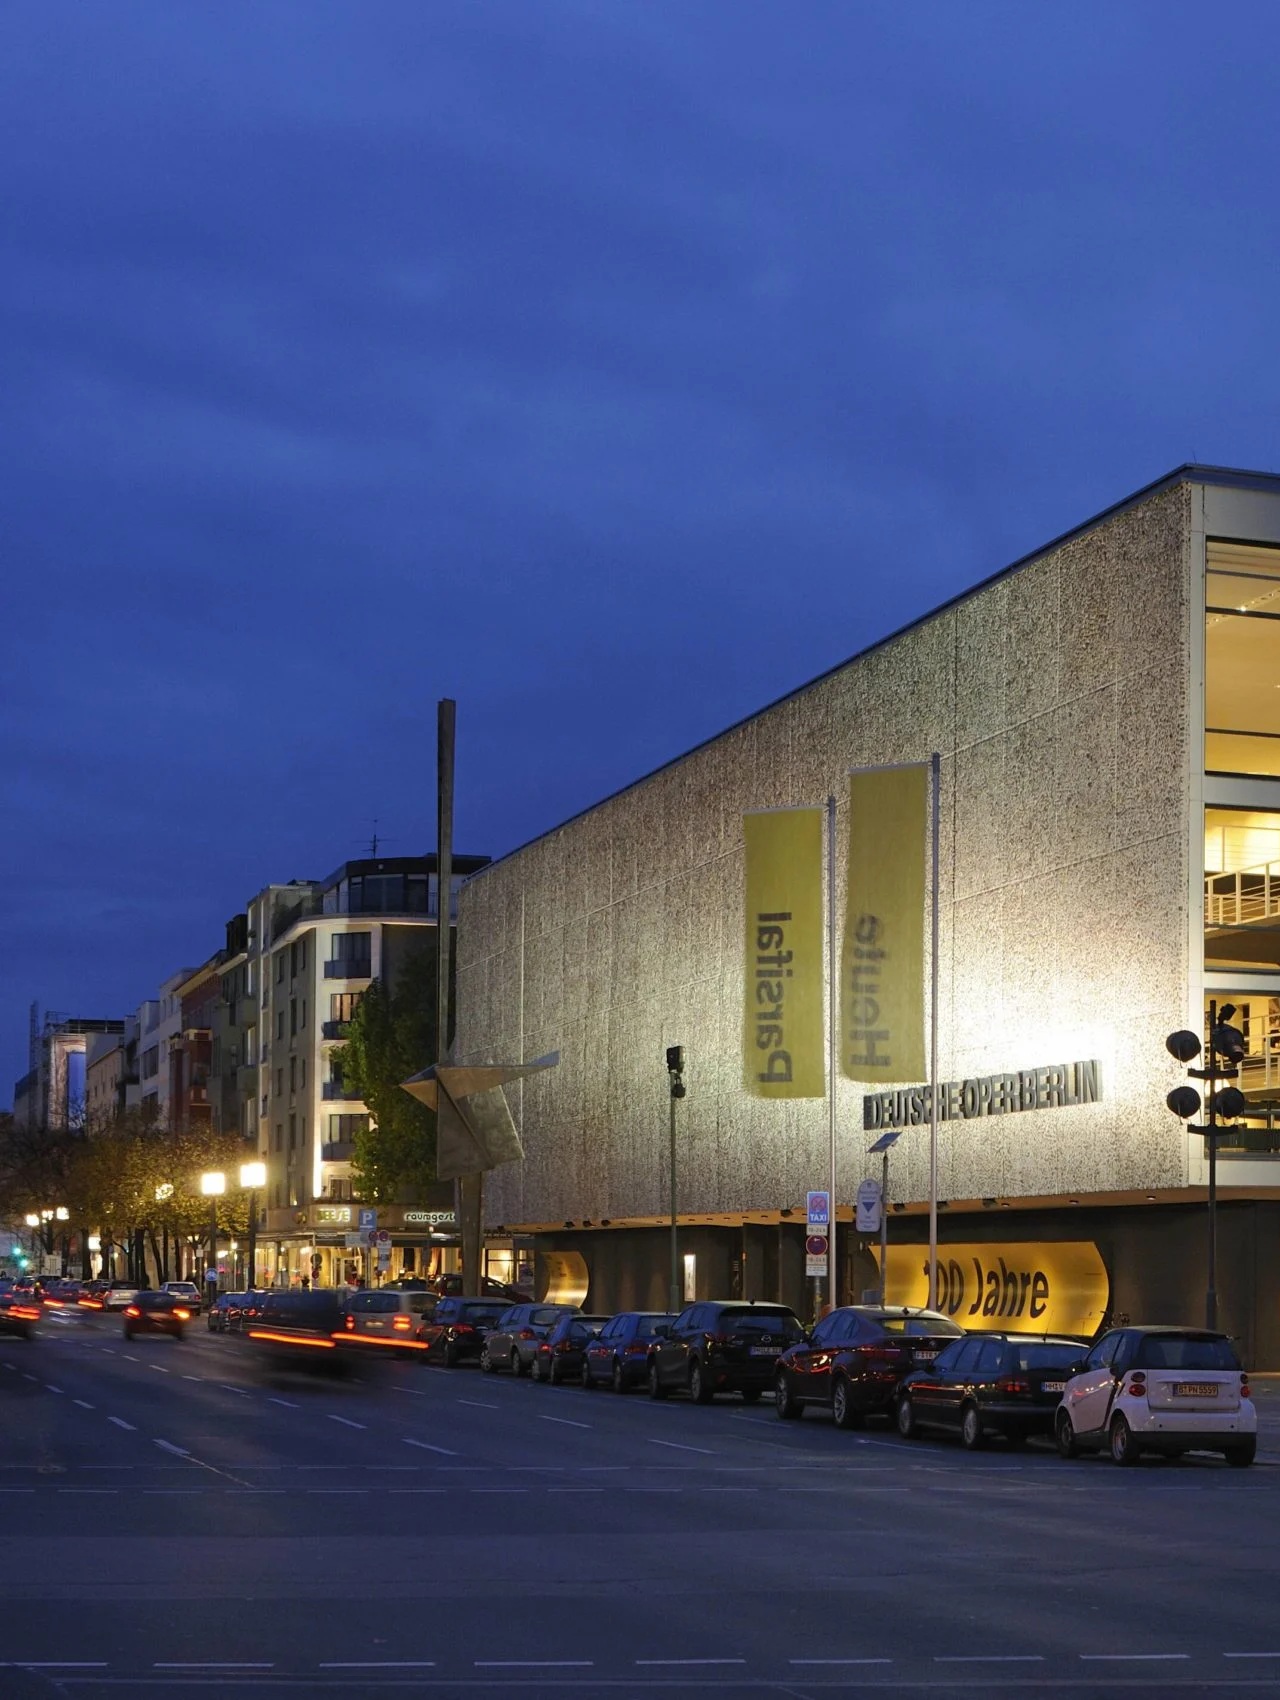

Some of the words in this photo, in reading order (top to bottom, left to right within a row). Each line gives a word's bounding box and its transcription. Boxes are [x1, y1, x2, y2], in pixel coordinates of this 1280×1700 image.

[863, 1081, 964, 1130] DEUTSCHE
[963, 1072, 1020, 1120] OPER
[1019, 1060, 1102, 1110] BERLIN
[362, 1213, 373, 1225] P
[405, 1212, 456, 1223] raumgest
[809, 1213, 827, 1222] TAXI
[968, 1257, 1049, 1319] Jahre
